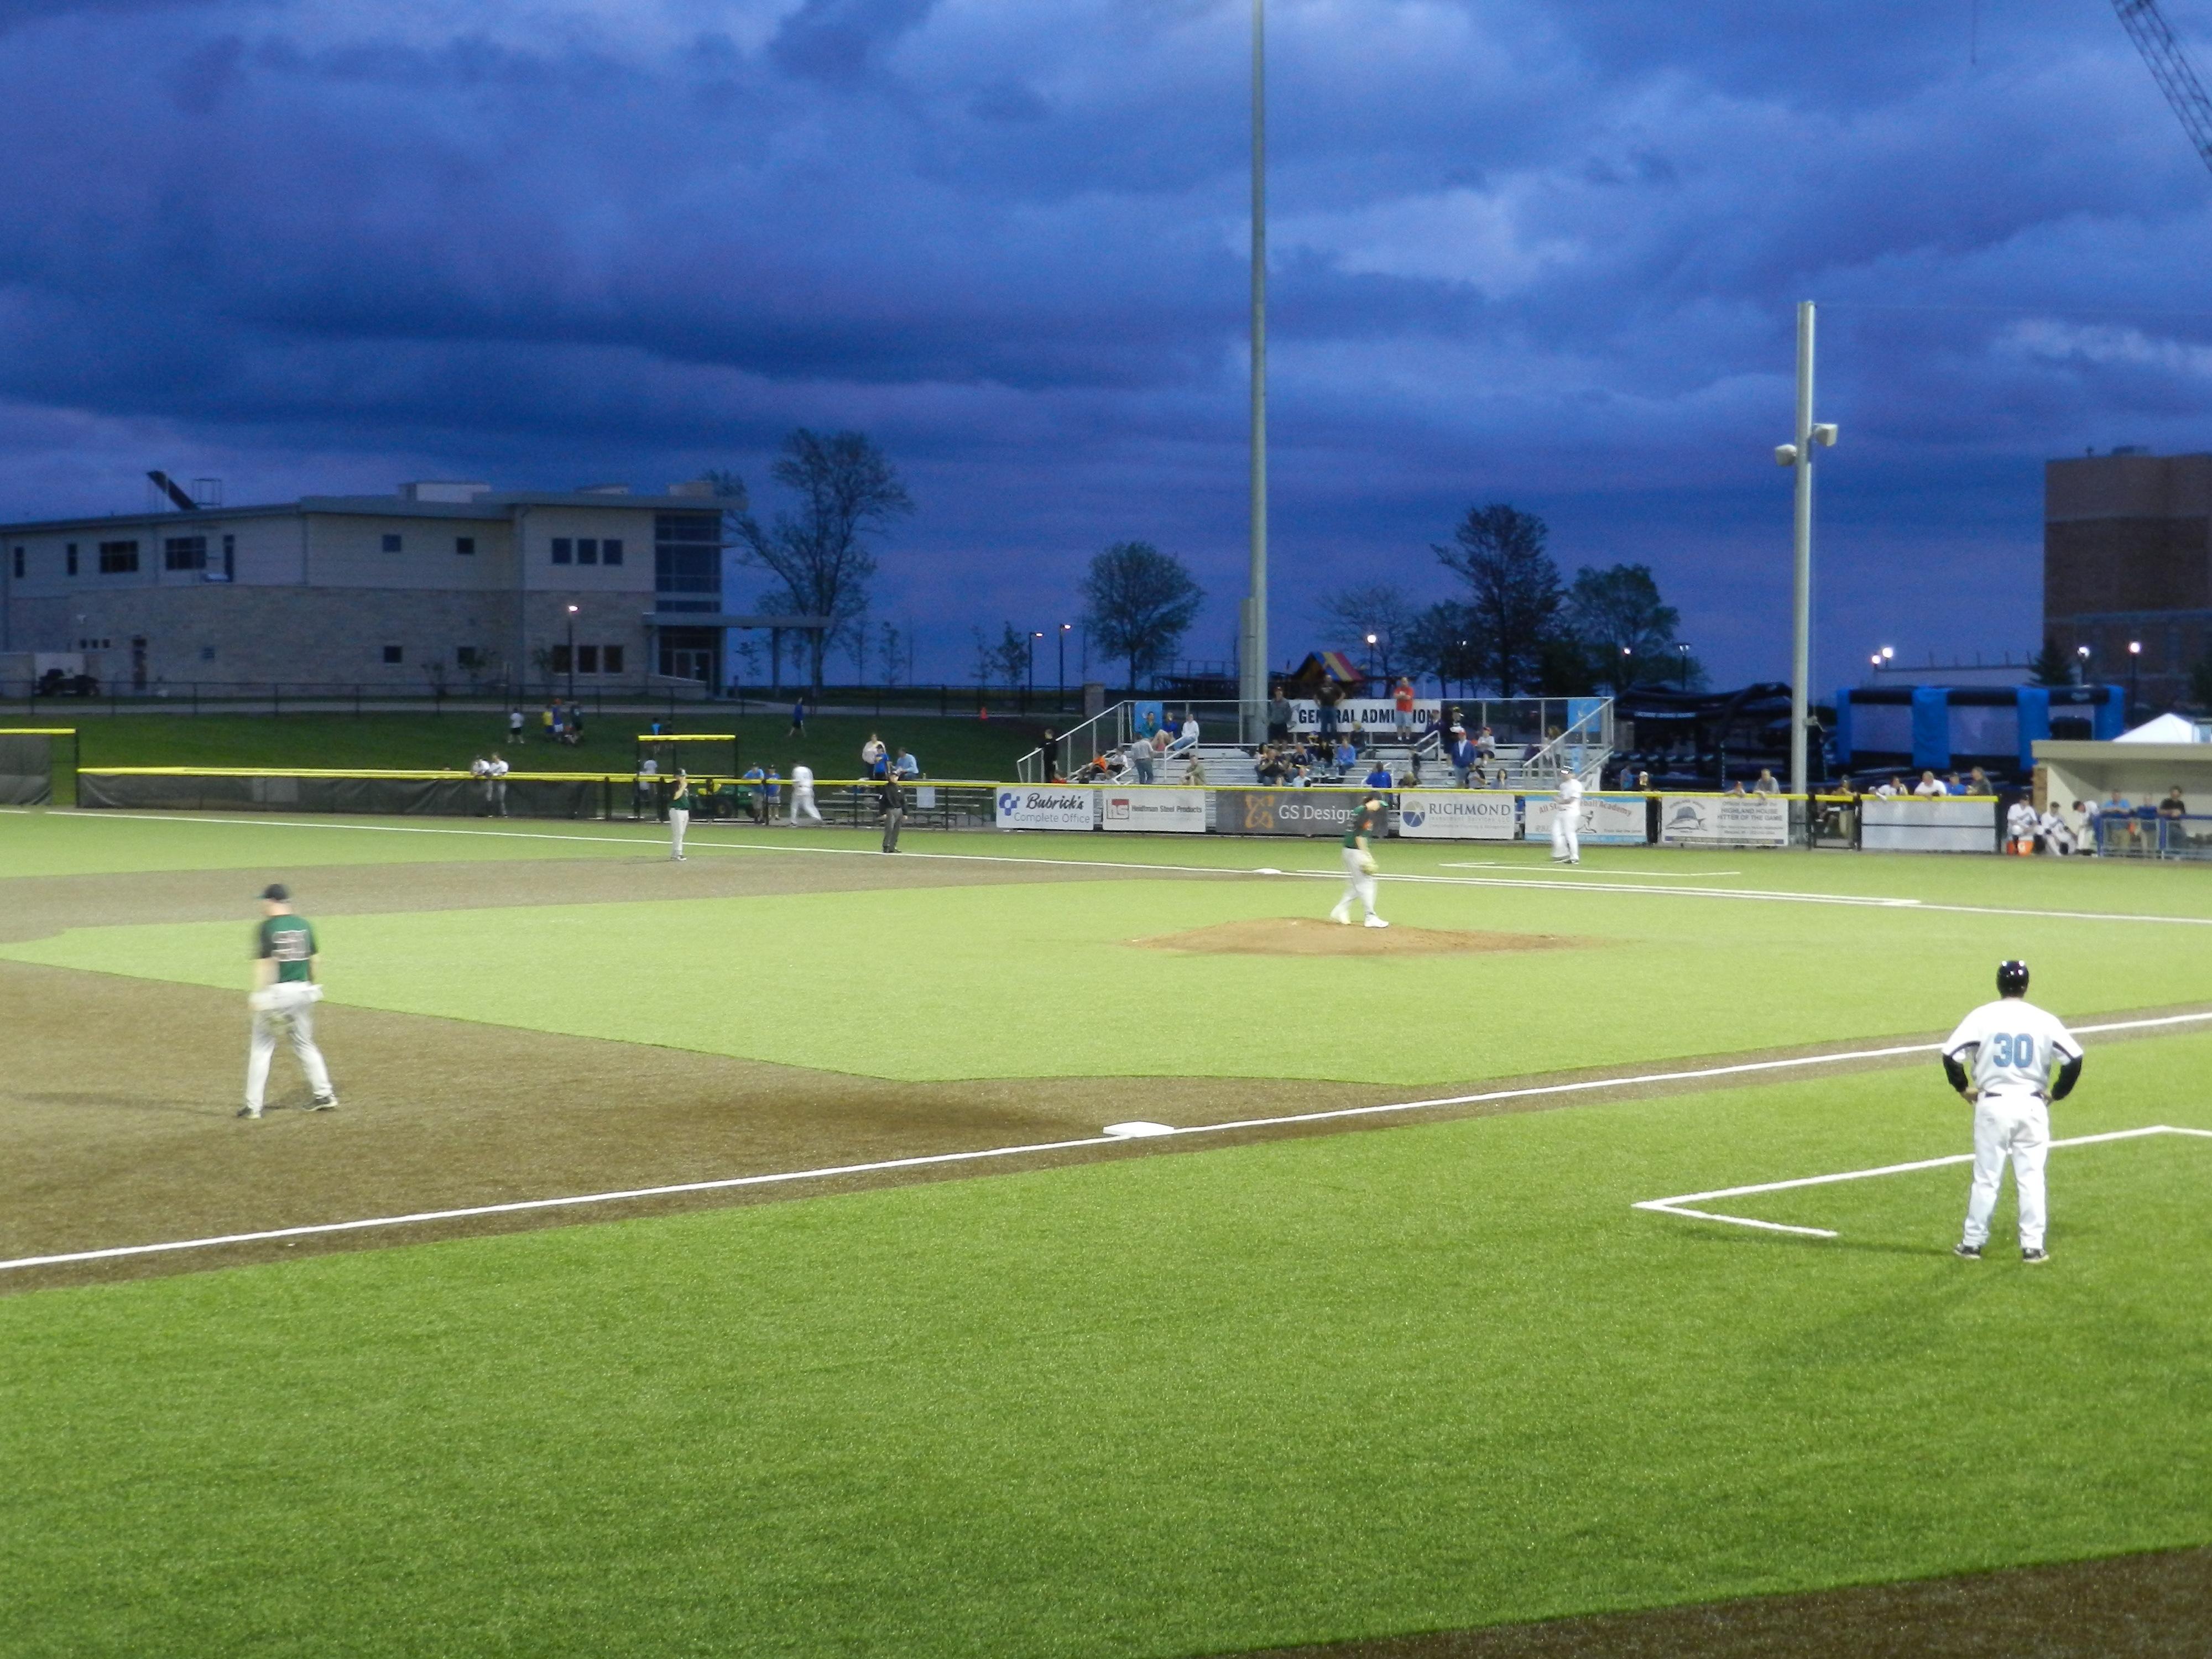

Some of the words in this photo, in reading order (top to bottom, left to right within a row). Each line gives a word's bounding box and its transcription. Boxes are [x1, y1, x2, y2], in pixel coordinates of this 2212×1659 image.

[1299, 709, 1354, 723] GERAL
[1361, 709, 1434, 723] ADMIIO
[1026, 792, 1084, 810] Bubrick's
[1279, 805, 1300, 819] GS
[1429, 803, 1511, 816] RICHMOND
[1539, 805, 1548, 813] All
[1599, 800, 1631, 817] Academy
[1014, 812, 1059, 823] Complete
[1062, 813, 1090, 823] Office
[1993, 1032, 2033, 1068] 30
